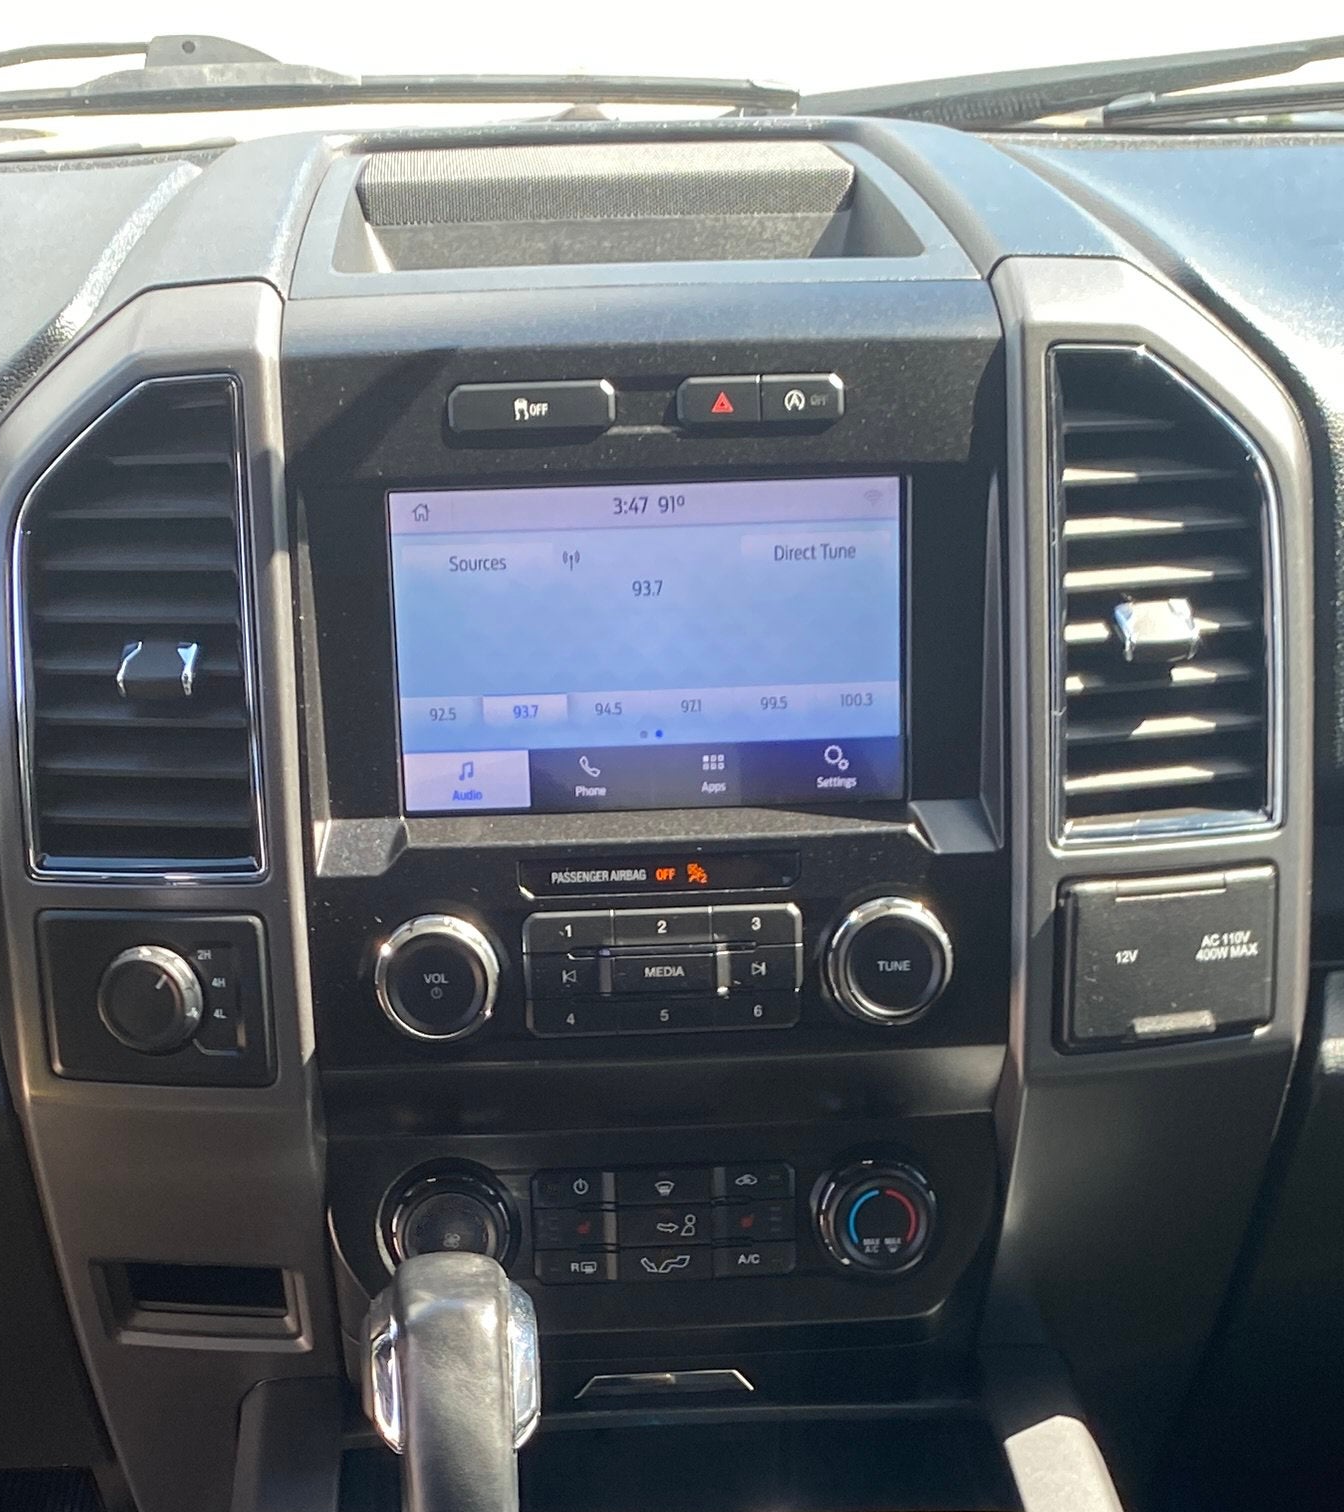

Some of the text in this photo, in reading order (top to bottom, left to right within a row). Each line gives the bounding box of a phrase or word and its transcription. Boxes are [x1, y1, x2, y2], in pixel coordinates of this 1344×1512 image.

[530, 403, 548, 416] OFF
[613, 496, 649, 515] 3:47
[774, 542, 856, 562] Direct Tune
[449, 555, 506, 573] Sources
[632, 580, 663, 598] 93.7
[760, 696, 788, 710] 99.5
[840, 693, 874, 707] 100.3
[430, 707, 456, 722] 92.5
[513, 705, 539, 719] 93.7
[594, 702, 622, 716] 94.5
[701, 782, 726, 794] Apps
[816, 776, 857, 789] Settings
[452, 788, 483, 802] Audio
[575, 786, 606, 797] Phone
[551, 868, 676, 884] PASSENGER AIRBAG OFF
[564, 924, 573, 937] 1
[657, 920, 668, 934] 2
[751, 917, 762, 930] 3
[1201, 931, 1251, 948] AC 110V
[197, 950, 212, 960] 2H
[1115, 949, 1138, 964] 12V
[1196, 942, 1258, 961] 400W MAX
[644, 966, 686, 978] MEDIA
[878, 960, 910, 972] TUNE
[211, 978, 226, 988] 4H
[423, 972, 449, 984] VOL
[213, 1008, 228, 1019] 4L
[660, 1008, 670, 1022] 5
[753, 1004, 762, 1017] 6
[566, 1013, 576, 1025] 4
[738, 1253, 760, 1266] A/C
